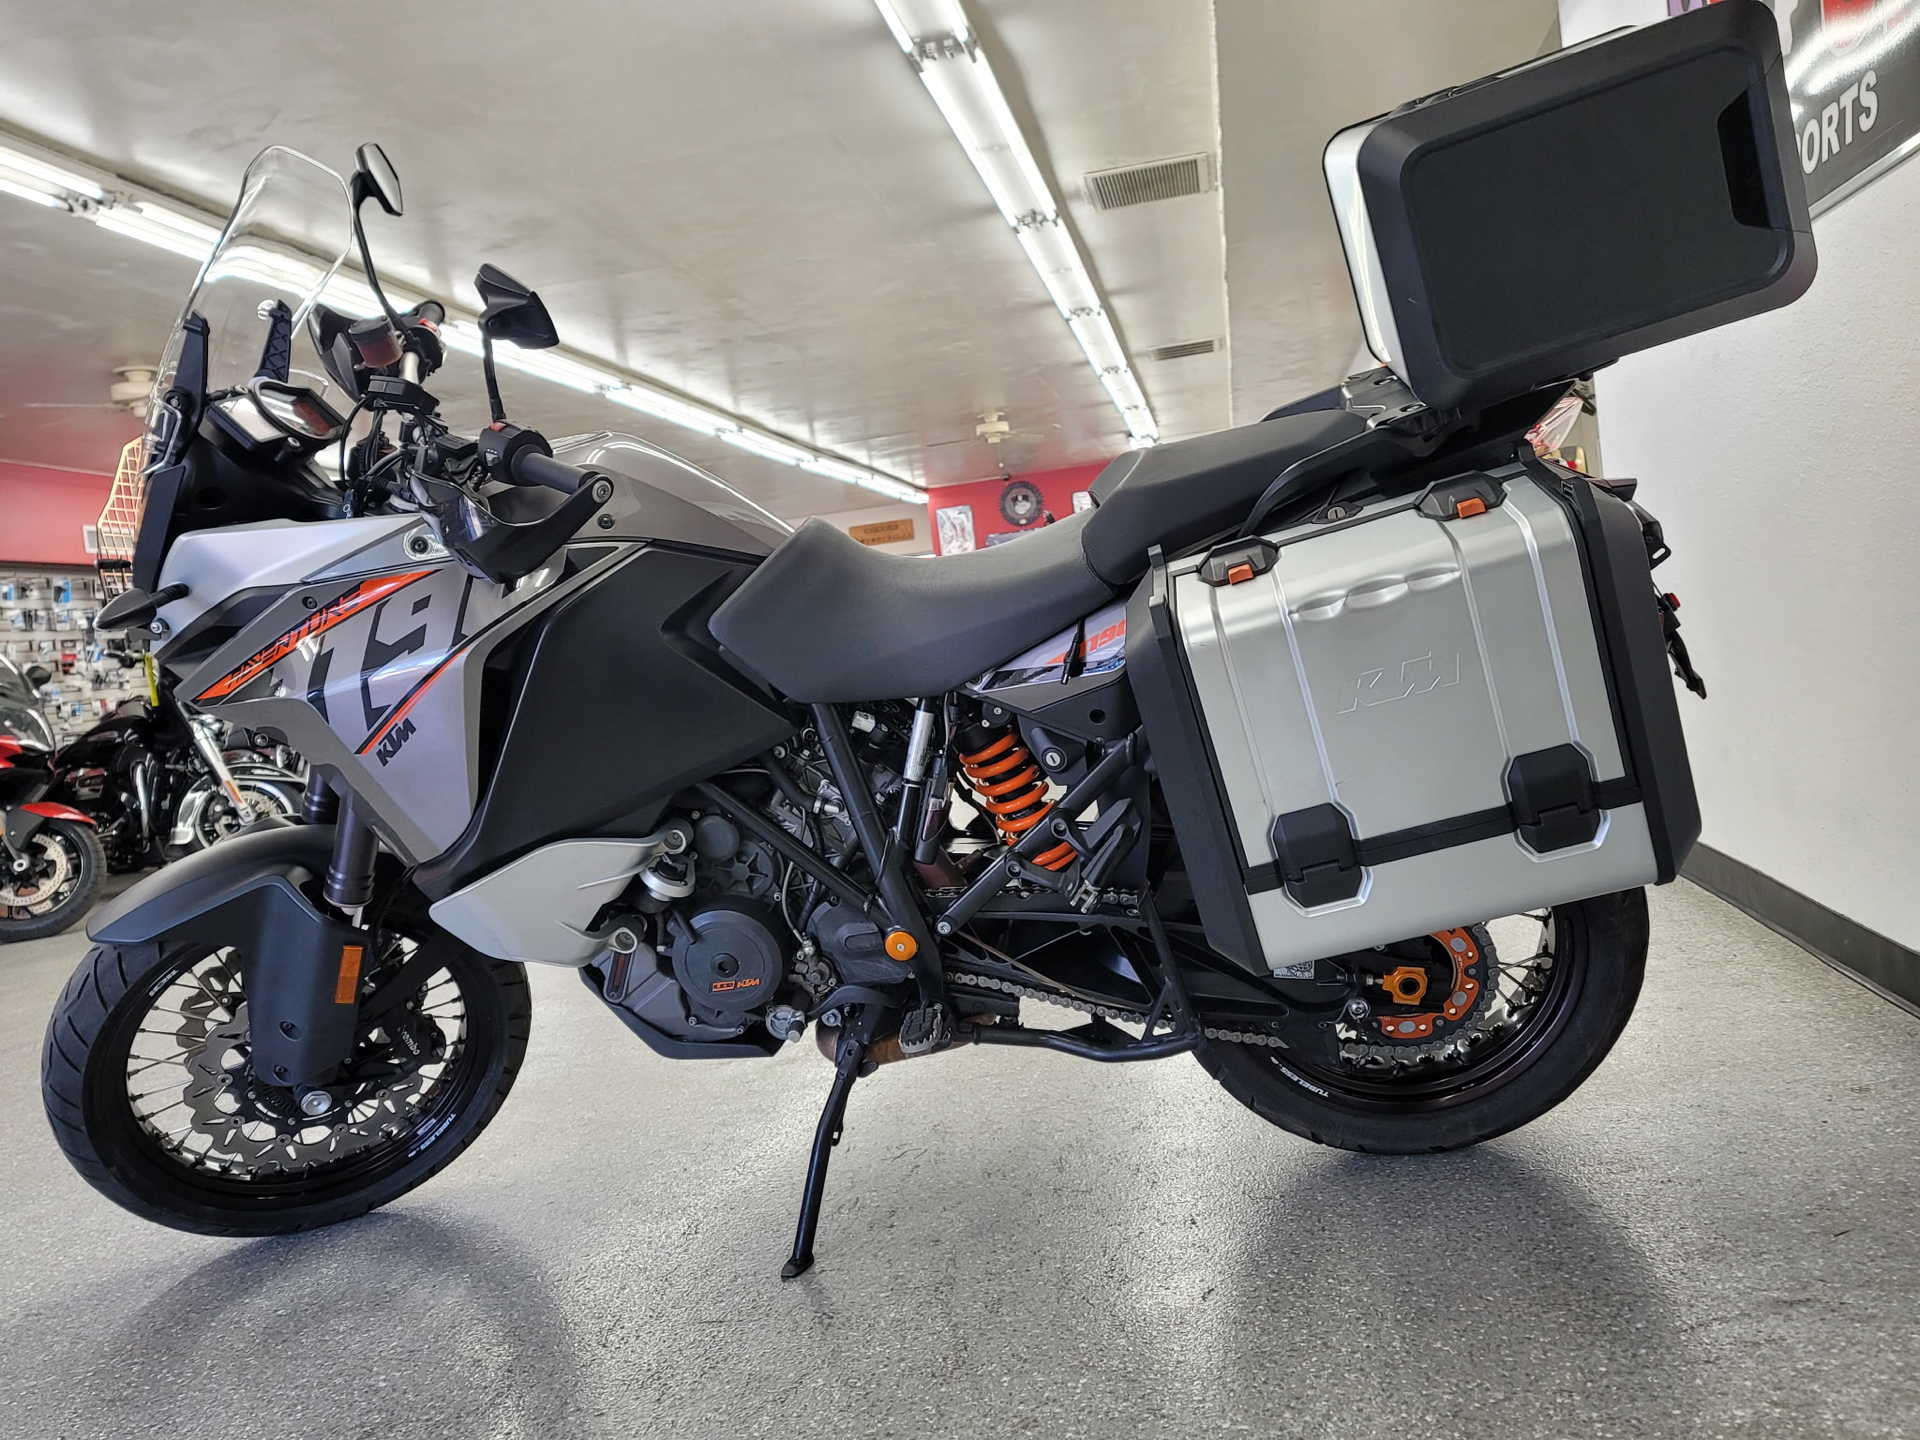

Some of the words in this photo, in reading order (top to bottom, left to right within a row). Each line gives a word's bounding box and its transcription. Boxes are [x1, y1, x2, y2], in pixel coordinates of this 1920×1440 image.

[1797, 70, 1878, 174] ORTS
[1337, 650, 1460, 714] KTM
[375, 717, 416, 767] KTM
[736, 978, 760, 988] KTM
